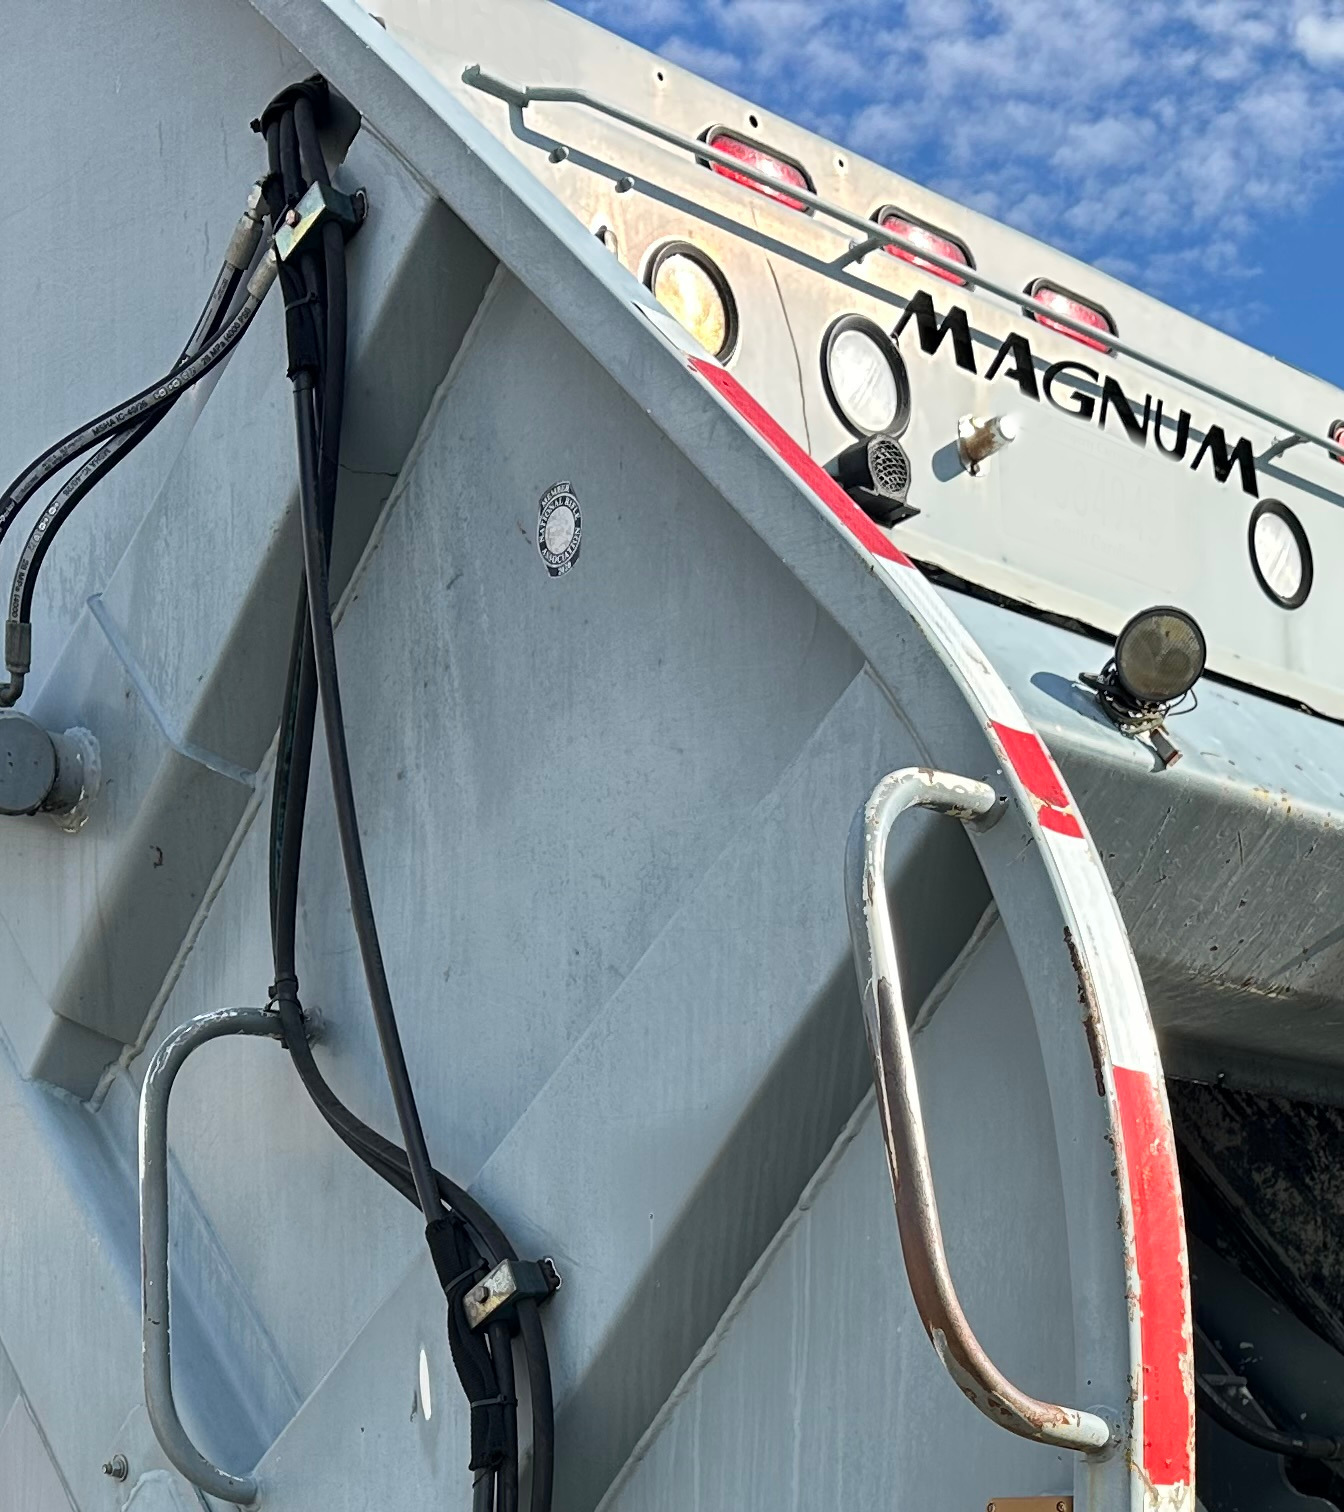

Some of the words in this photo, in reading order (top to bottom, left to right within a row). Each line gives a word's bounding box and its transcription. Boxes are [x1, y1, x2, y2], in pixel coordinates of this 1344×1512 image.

[892, 290, 1258, 497] MAGNUM
[91, 419, 116, 436] MSHA
[541, 484, 571, 508] MEMBER
[539, 497, 564, 543] NATIONAL
[564, 496, 582, 521] RIFLE
[541, 527, 582, 565] ASSOCIATION
